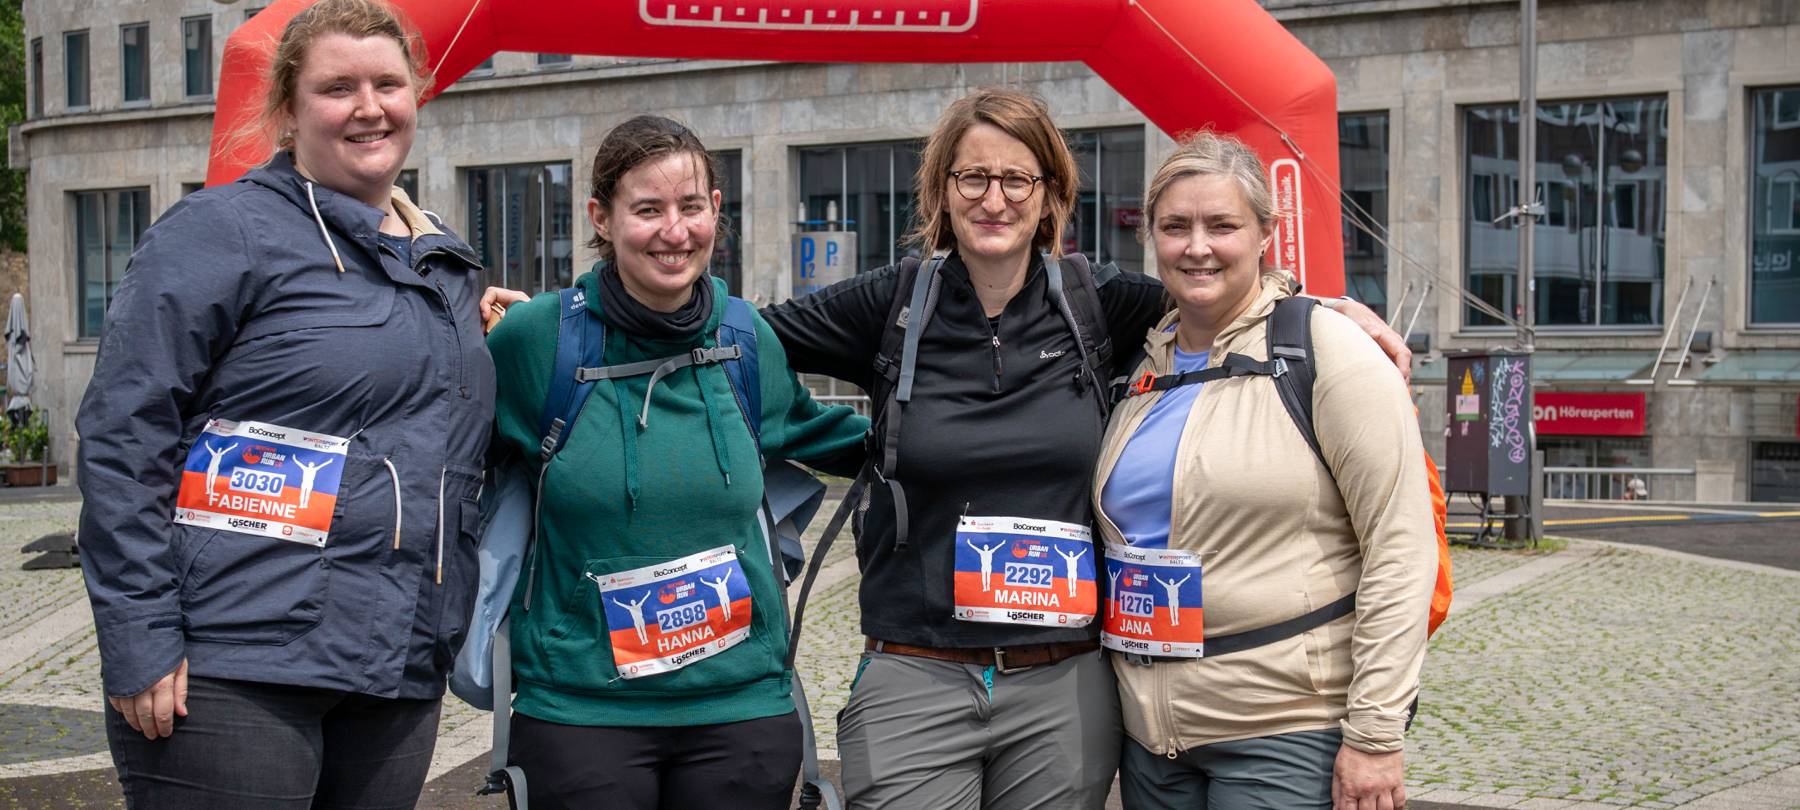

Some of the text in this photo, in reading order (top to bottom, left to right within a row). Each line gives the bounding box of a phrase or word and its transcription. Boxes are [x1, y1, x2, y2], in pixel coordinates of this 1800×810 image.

[1284, 212, 1295, 243] beste
[1286, 244, 1296, 261] die
[1559, 405, 1634, 420] Hörexperten
[248, 427, 287, 440] BoConcept
[231, 471, 283, 493] 3030
[209, 492, 298, 519] FABIENNE
[227, 517, 268, 530] LÖSCHER
[1013, 522, 1046, 533] BoConcept
[653, 564, 688, 578] BoConcept
[1005, 565, 1051, 586] 2292
[676, 582, 695, 592] URBAN
[994, 589, 1060, 607] MARINA
[1120, 594, 1153, 615] 1276
[659, 603, 706, 632] 2898
[1007, 611, 1045, 621] LÖSCHER
[1120, 619, 1153, 635] JANA
[657, 625, 715, 653] HANNA
[1121, 639, 1149, 649] LÖSCHER
[671, 647, 706, 665] LÖSCHER
